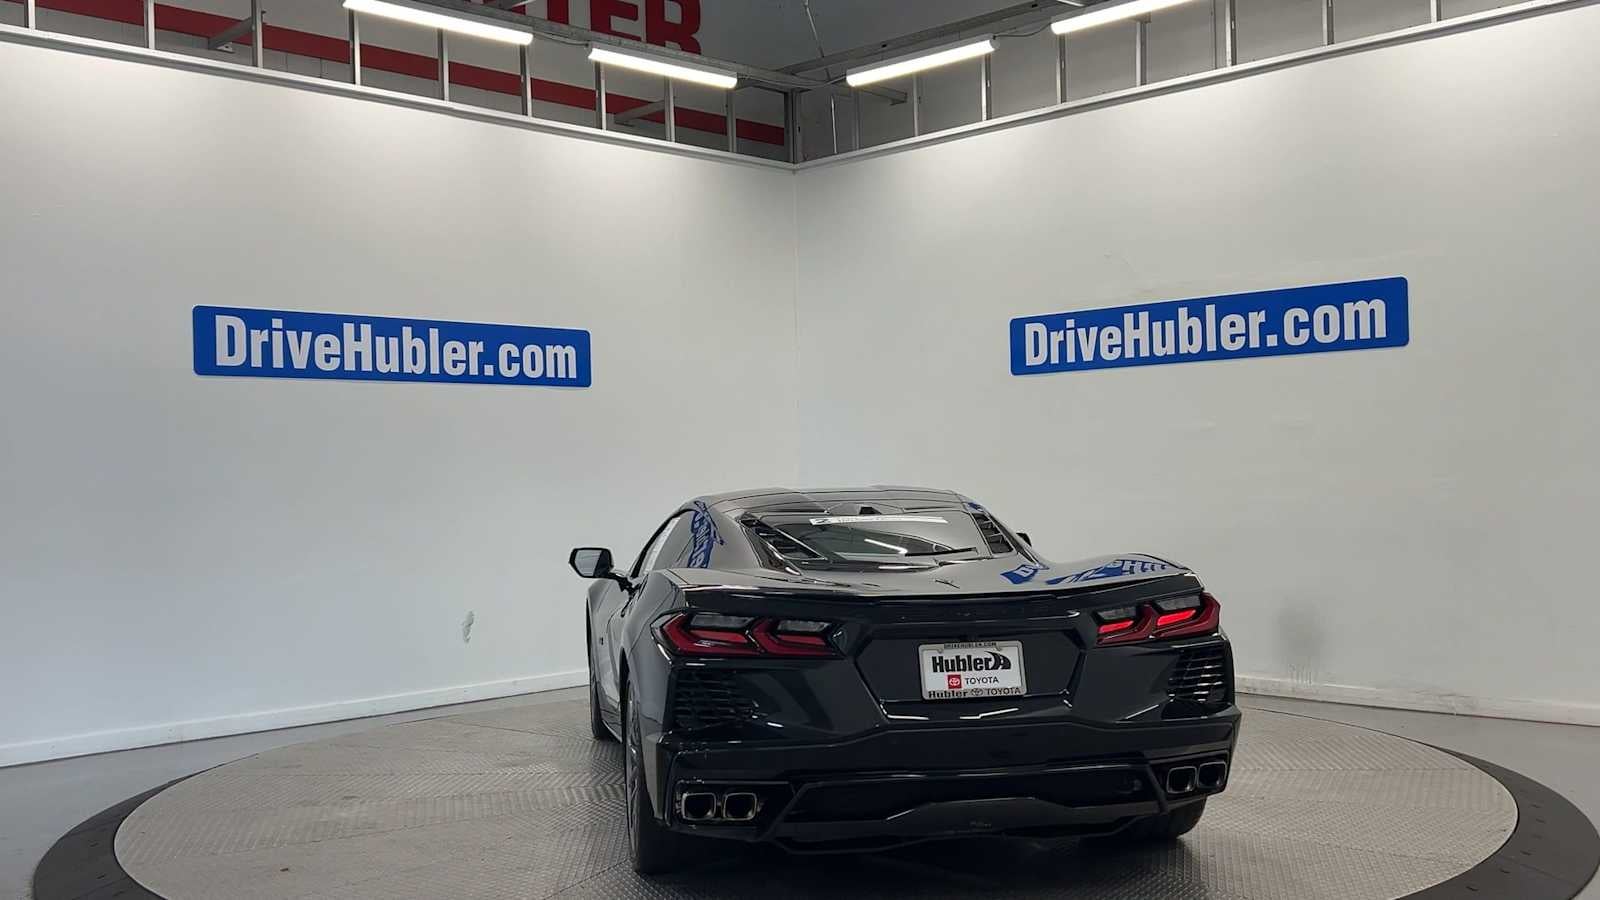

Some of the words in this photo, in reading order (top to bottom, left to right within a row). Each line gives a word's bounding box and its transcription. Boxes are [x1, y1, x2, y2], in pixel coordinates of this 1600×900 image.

[1024, 297, 1387, 367] DriveHubler.com
[214, 313, 578, 380] DriveHubler.com
[931, 654, 993, 673] Hubler
[964, 676, 999, 685] TOYOTA
[928, 690, 968, 699] Hubler
[986, 687, 1022, 696] TOYOTA
